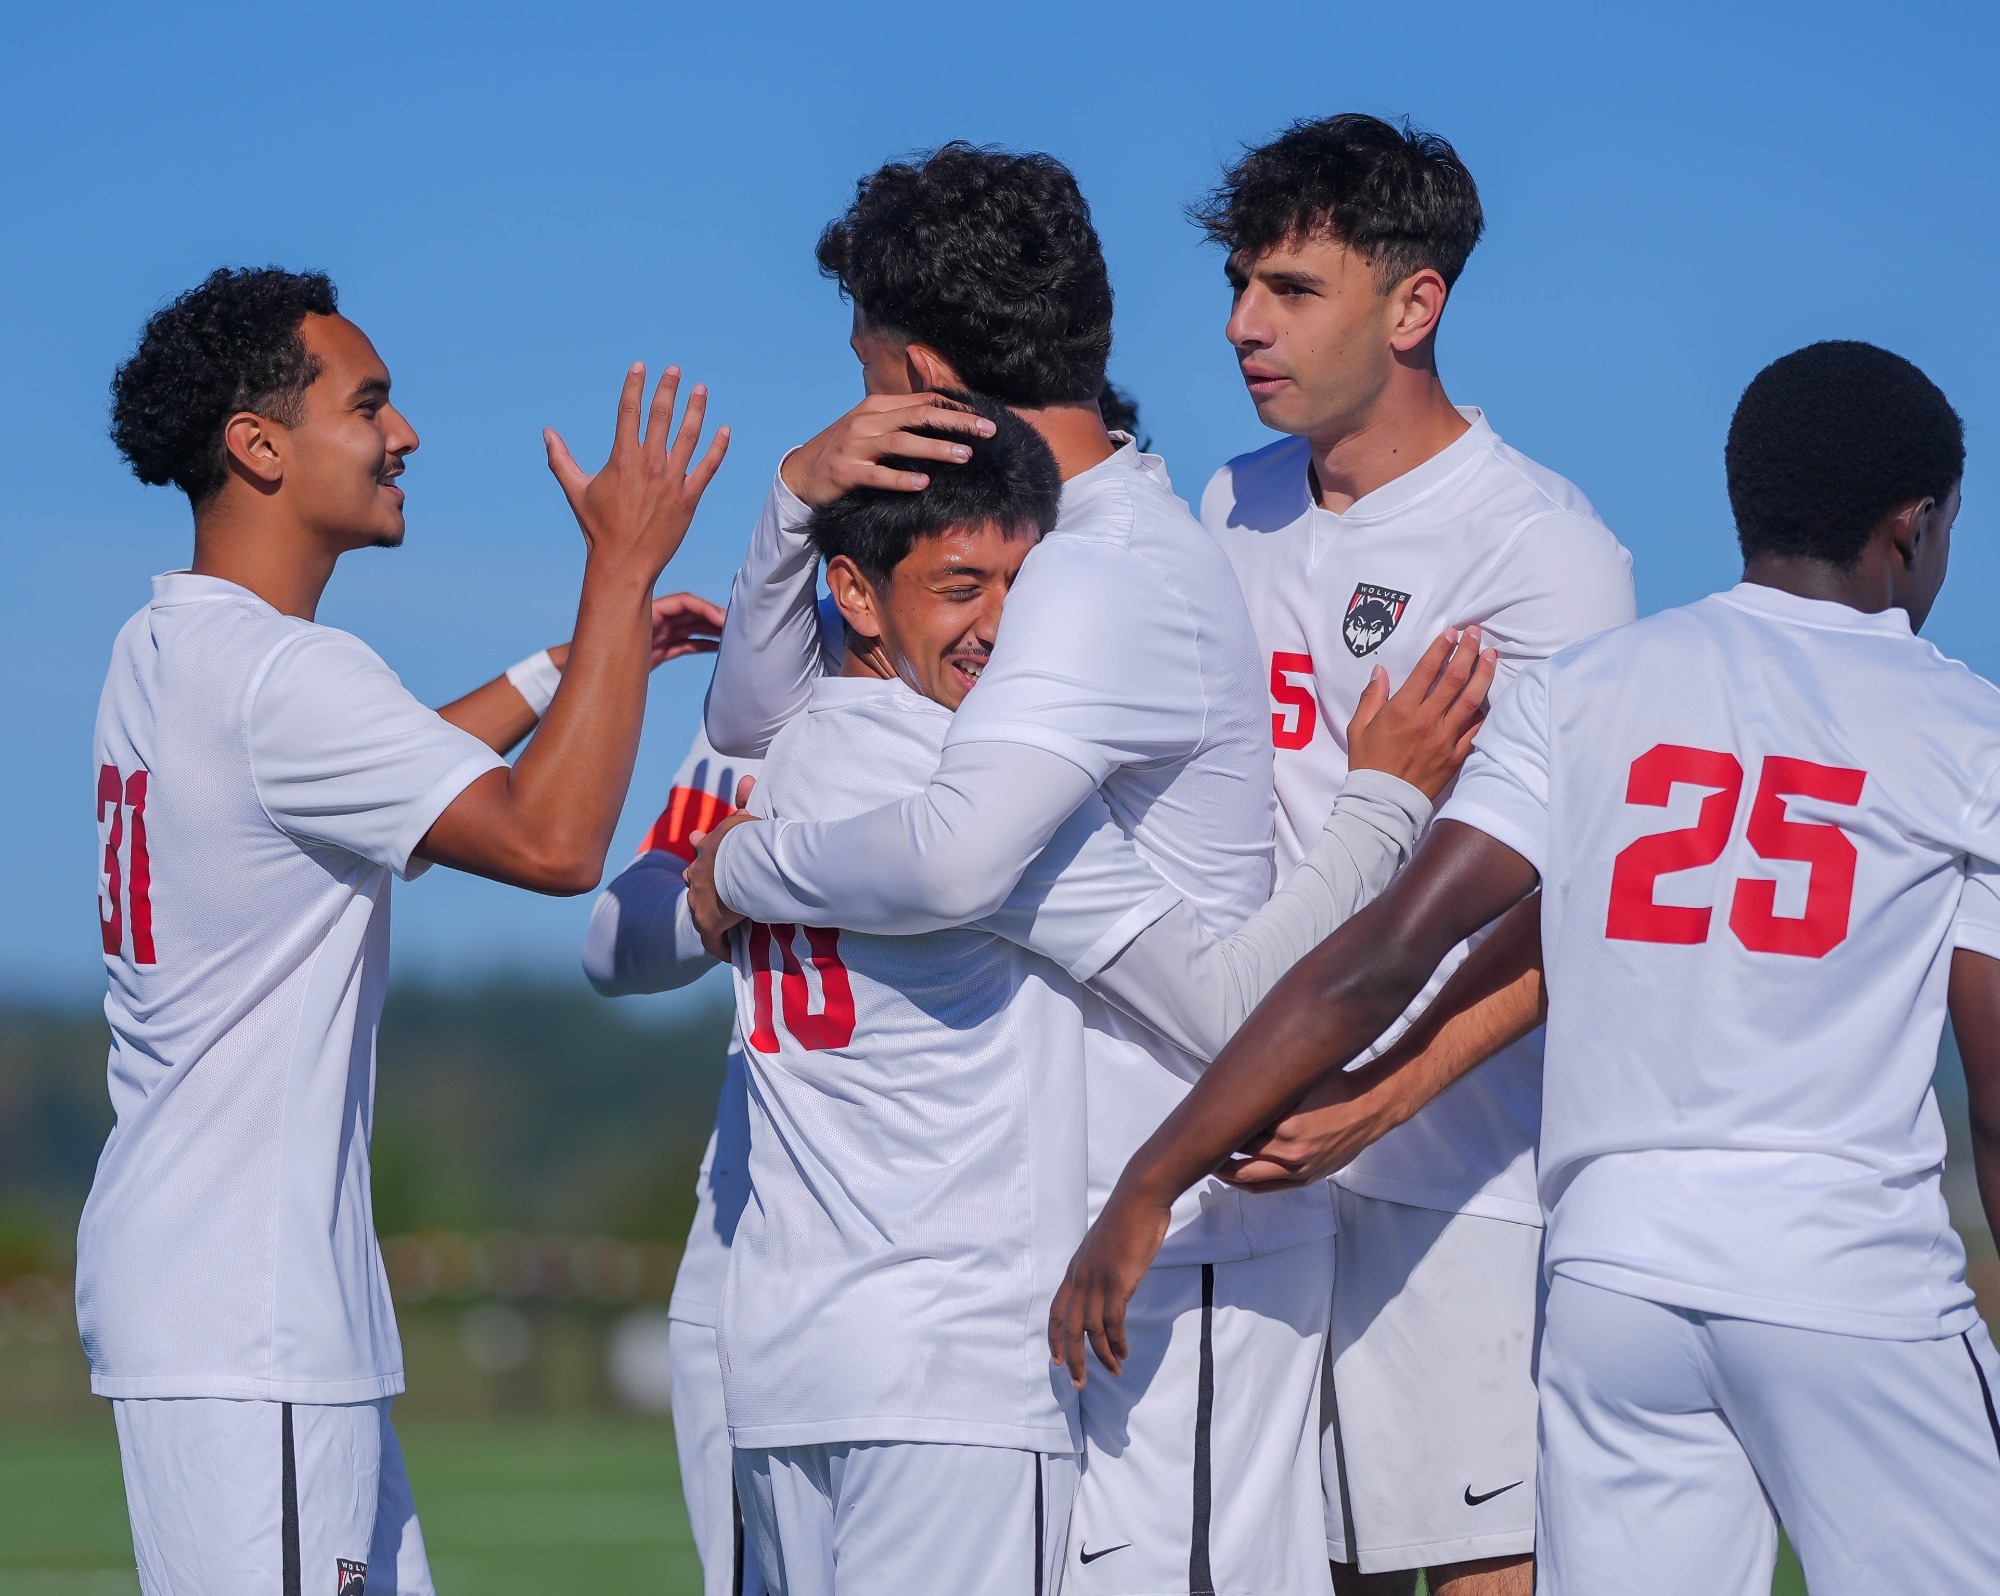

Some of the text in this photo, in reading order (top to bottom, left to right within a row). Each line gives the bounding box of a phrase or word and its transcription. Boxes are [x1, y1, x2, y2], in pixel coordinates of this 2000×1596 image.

[1361, 586, 1406, 602] WOLVES
[1270, 651, 1317, 750] 5
[97, 764, 157, 965] 31
[1605, 743, 1867, 959] 25
[341, 1561, 367, 1572] WOLV
